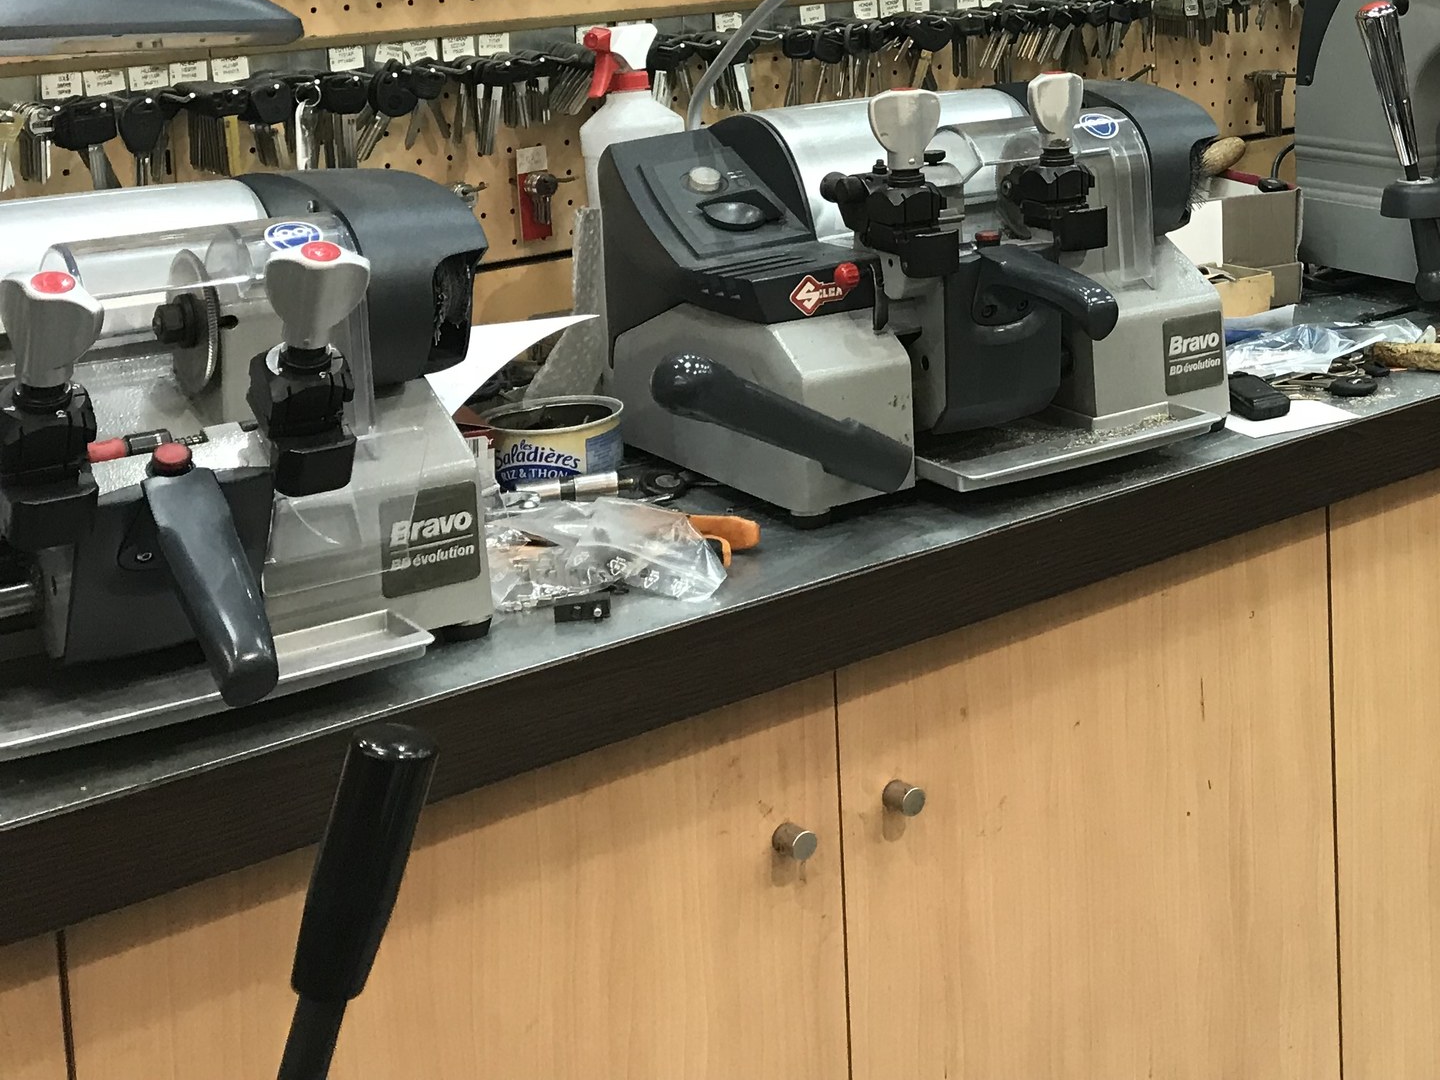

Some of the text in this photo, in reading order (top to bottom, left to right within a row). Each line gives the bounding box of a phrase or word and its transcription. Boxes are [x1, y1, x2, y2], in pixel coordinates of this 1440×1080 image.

[1169, 331, 1220, 356] Bravo
[1169, 357, 1221, 376] BD évolution
[520, 439, 533, 451] les
[519, 468, 527, 478] &
[391, 510, 472, 547] Bravo
[413, 542, 475, 569] évolution
